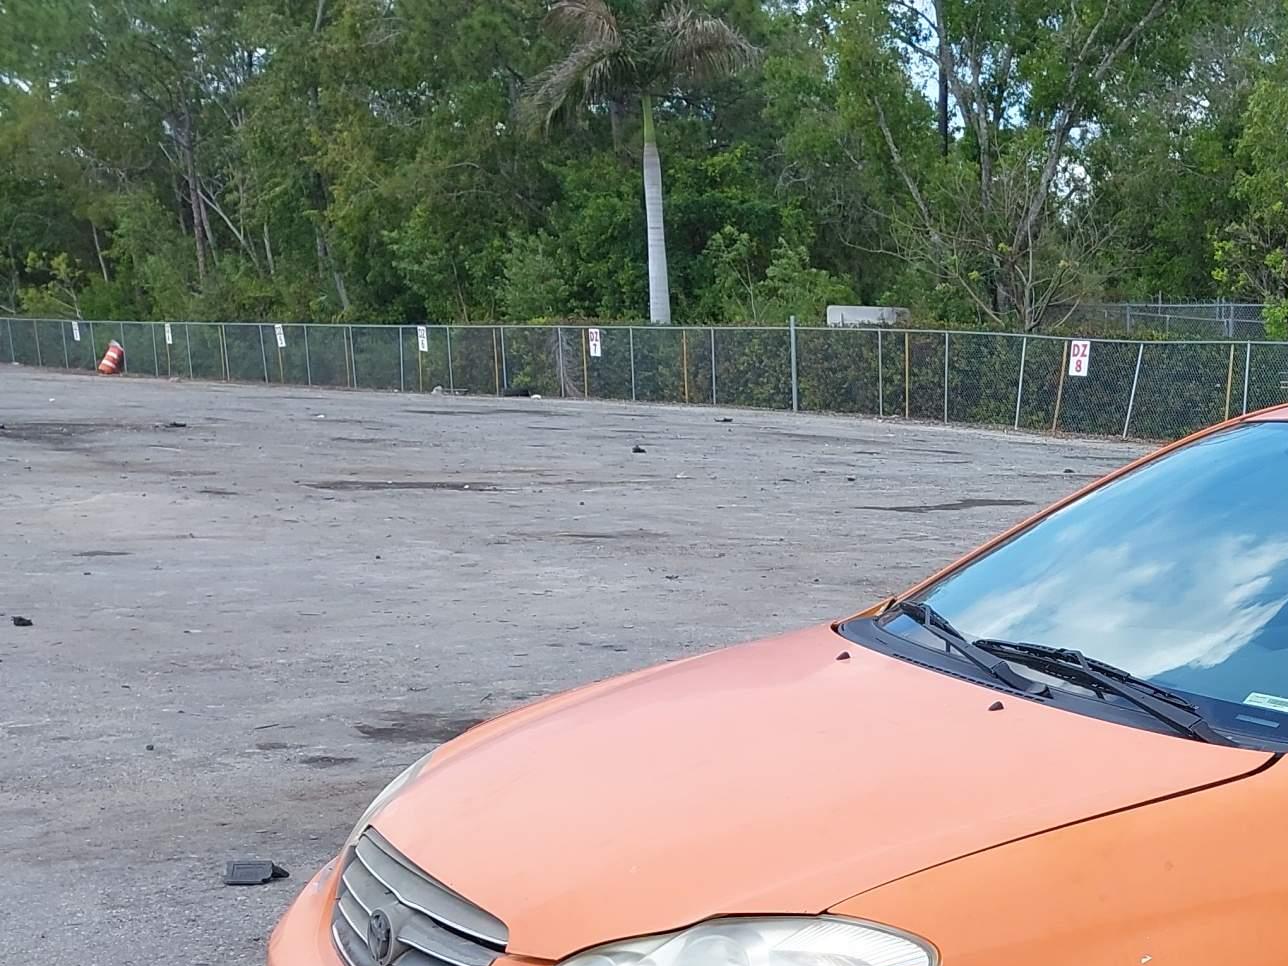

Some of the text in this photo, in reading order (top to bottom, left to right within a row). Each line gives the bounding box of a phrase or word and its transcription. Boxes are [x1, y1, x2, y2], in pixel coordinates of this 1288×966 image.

[592, 343, 598, 355] 7
[1071, 343, 1088, 358] DZ
[1075, 359, 1083, 373] 8
